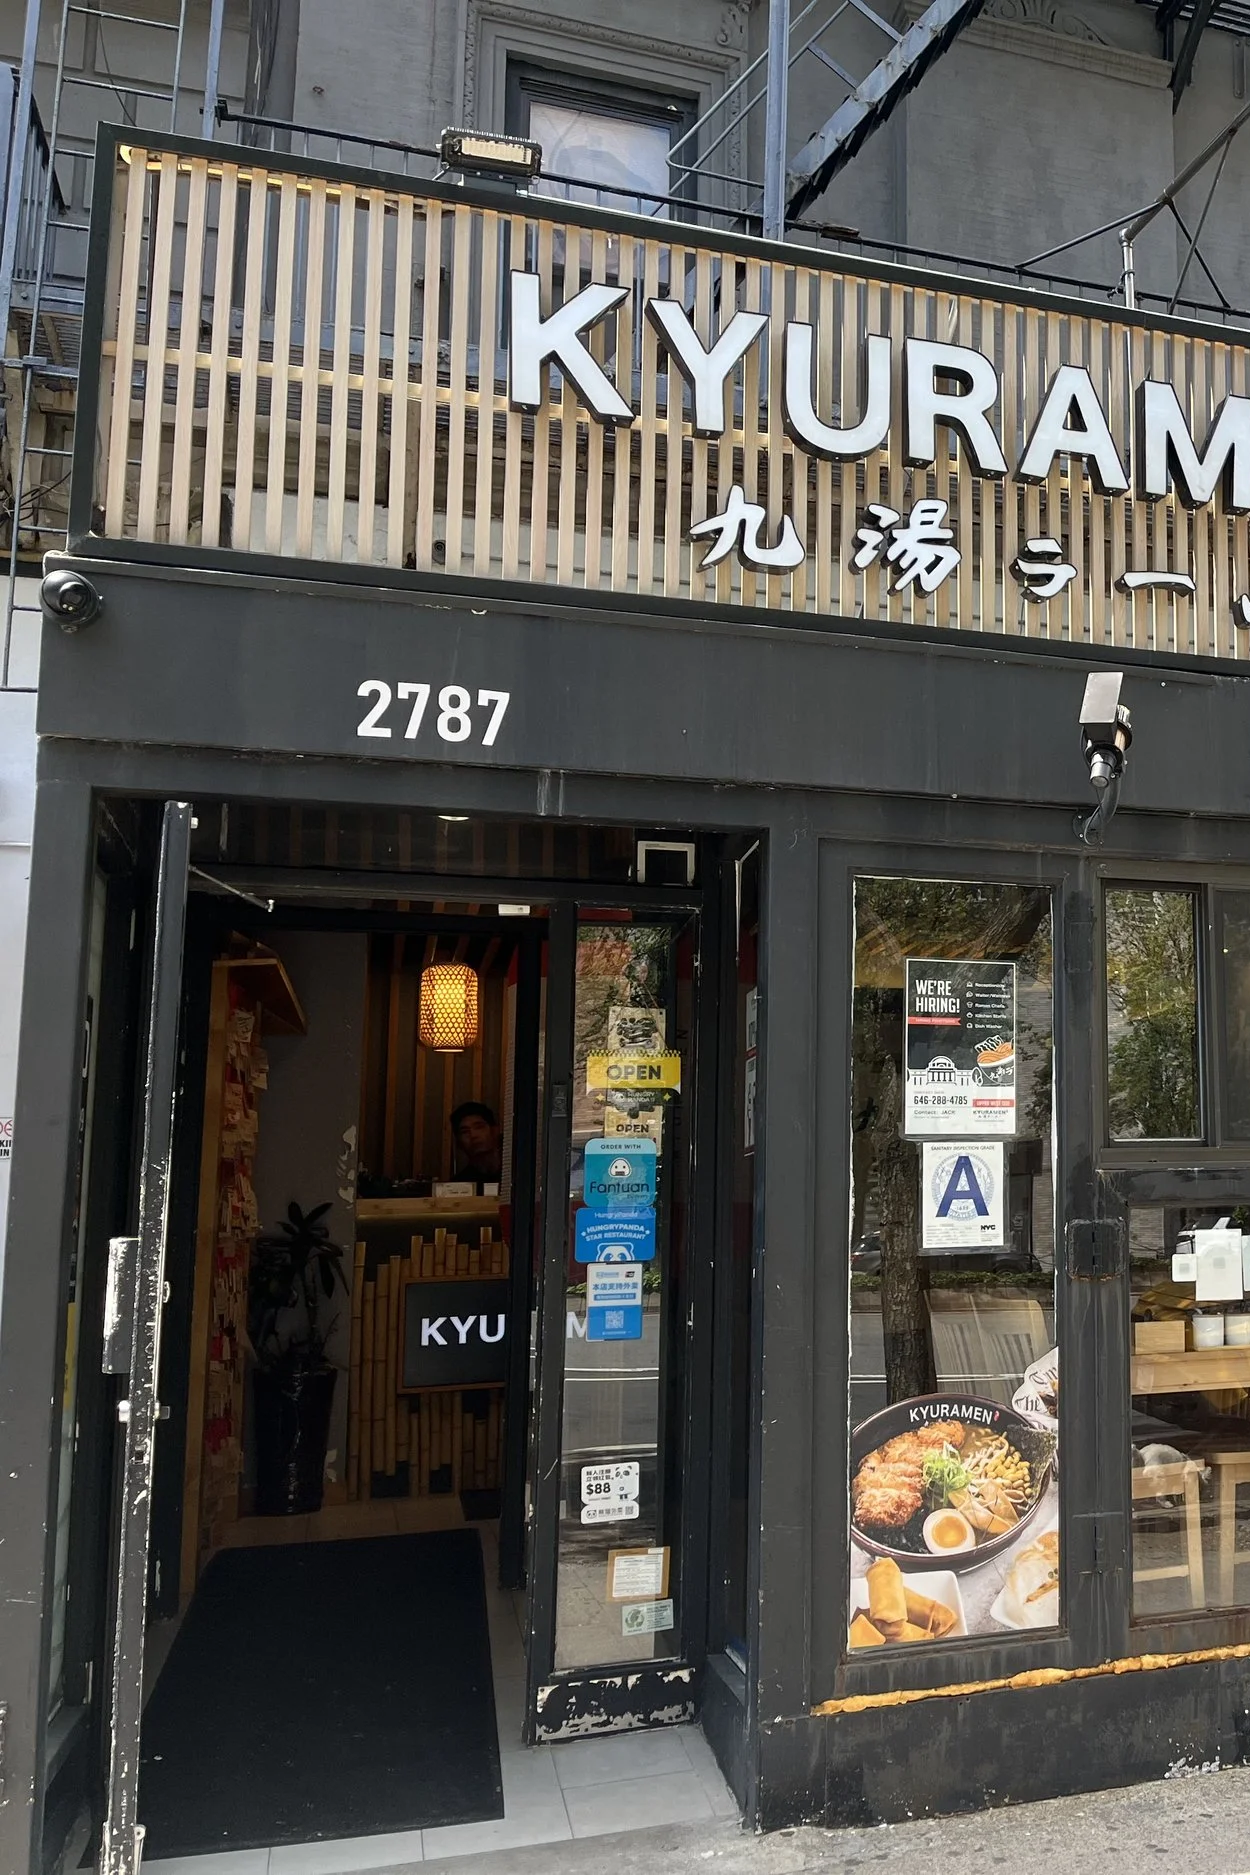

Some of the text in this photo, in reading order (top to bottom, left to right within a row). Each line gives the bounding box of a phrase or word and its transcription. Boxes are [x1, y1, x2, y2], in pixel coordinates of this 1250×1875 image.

[357, 680, 510, 746] 2787
[915, 980, 952, 996] WE'RE
[915, 997, 960, 1013] HIRING!
[606, 1064, 662, 1081] OPEN
[616, 1124, 650, 1133] OPEN
[589, 1181, 650, 1194] Fantuan
[935, 1155, 990, 1218] A
[585, 1231, 647, 1241] STAR RESTAURANT
[586, 1224, 645, 1234] HUNGRYPANDA
[909, 1403, 993, 1425] KYURAMEN
[586, 1482, 611, 1497] $88
